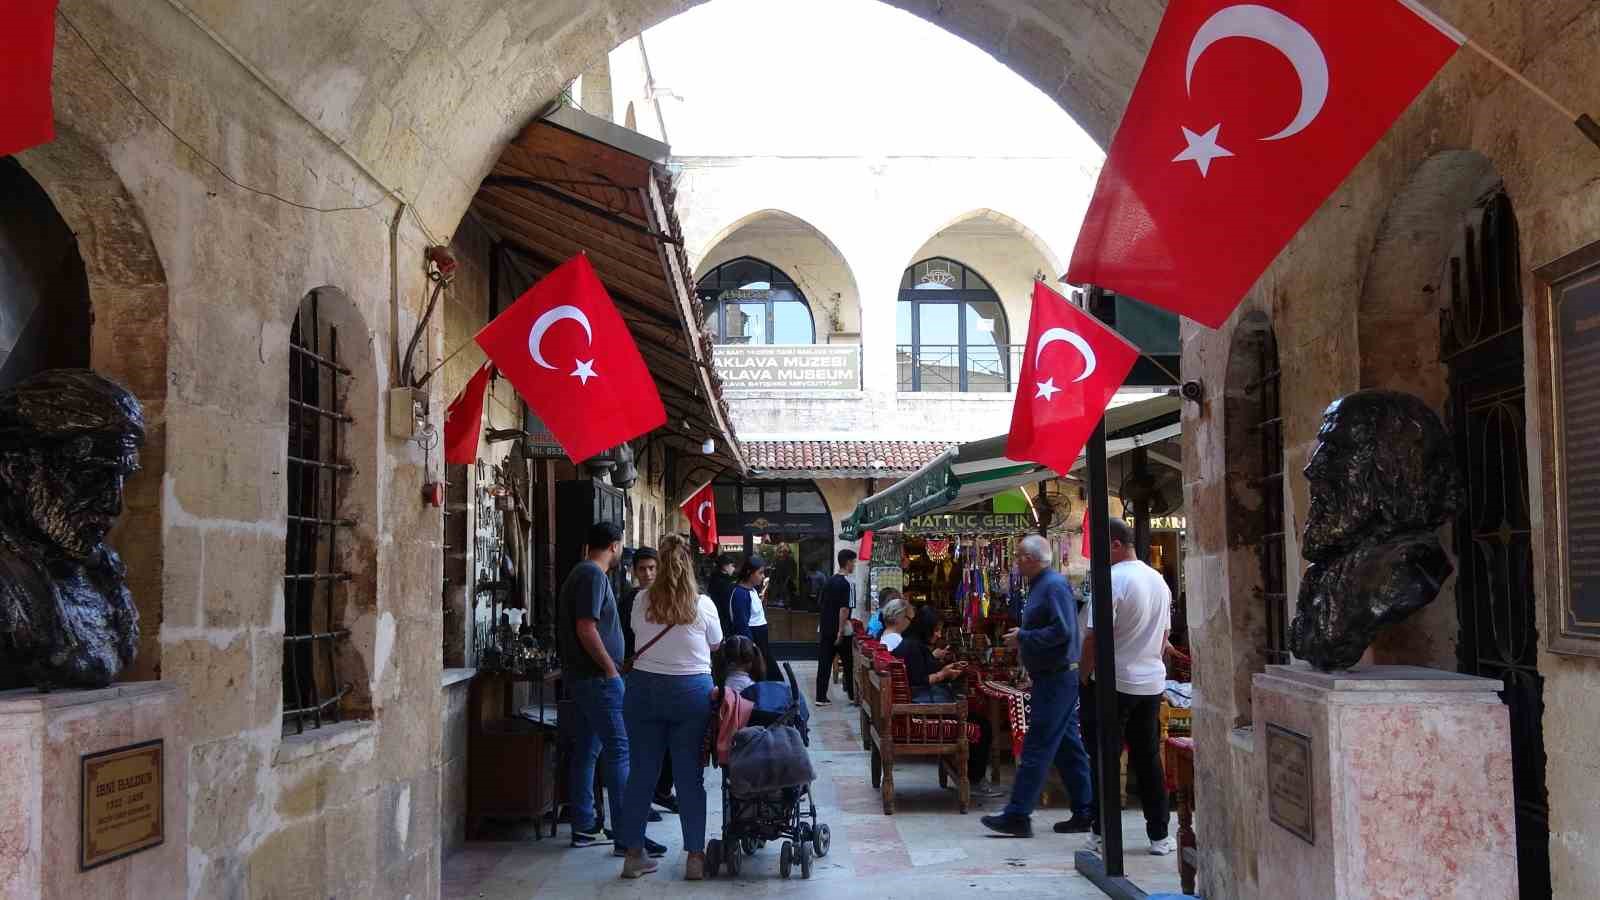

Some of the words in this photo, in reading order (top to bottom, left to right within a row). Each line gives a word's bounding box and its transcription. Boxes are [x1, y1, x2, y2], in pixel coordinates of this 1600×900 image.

[714, 357, 778, 368] AKLAVA
[717, 369, 773, 380] KLAVA
[777, 369, 853, 380] MUSEUM
